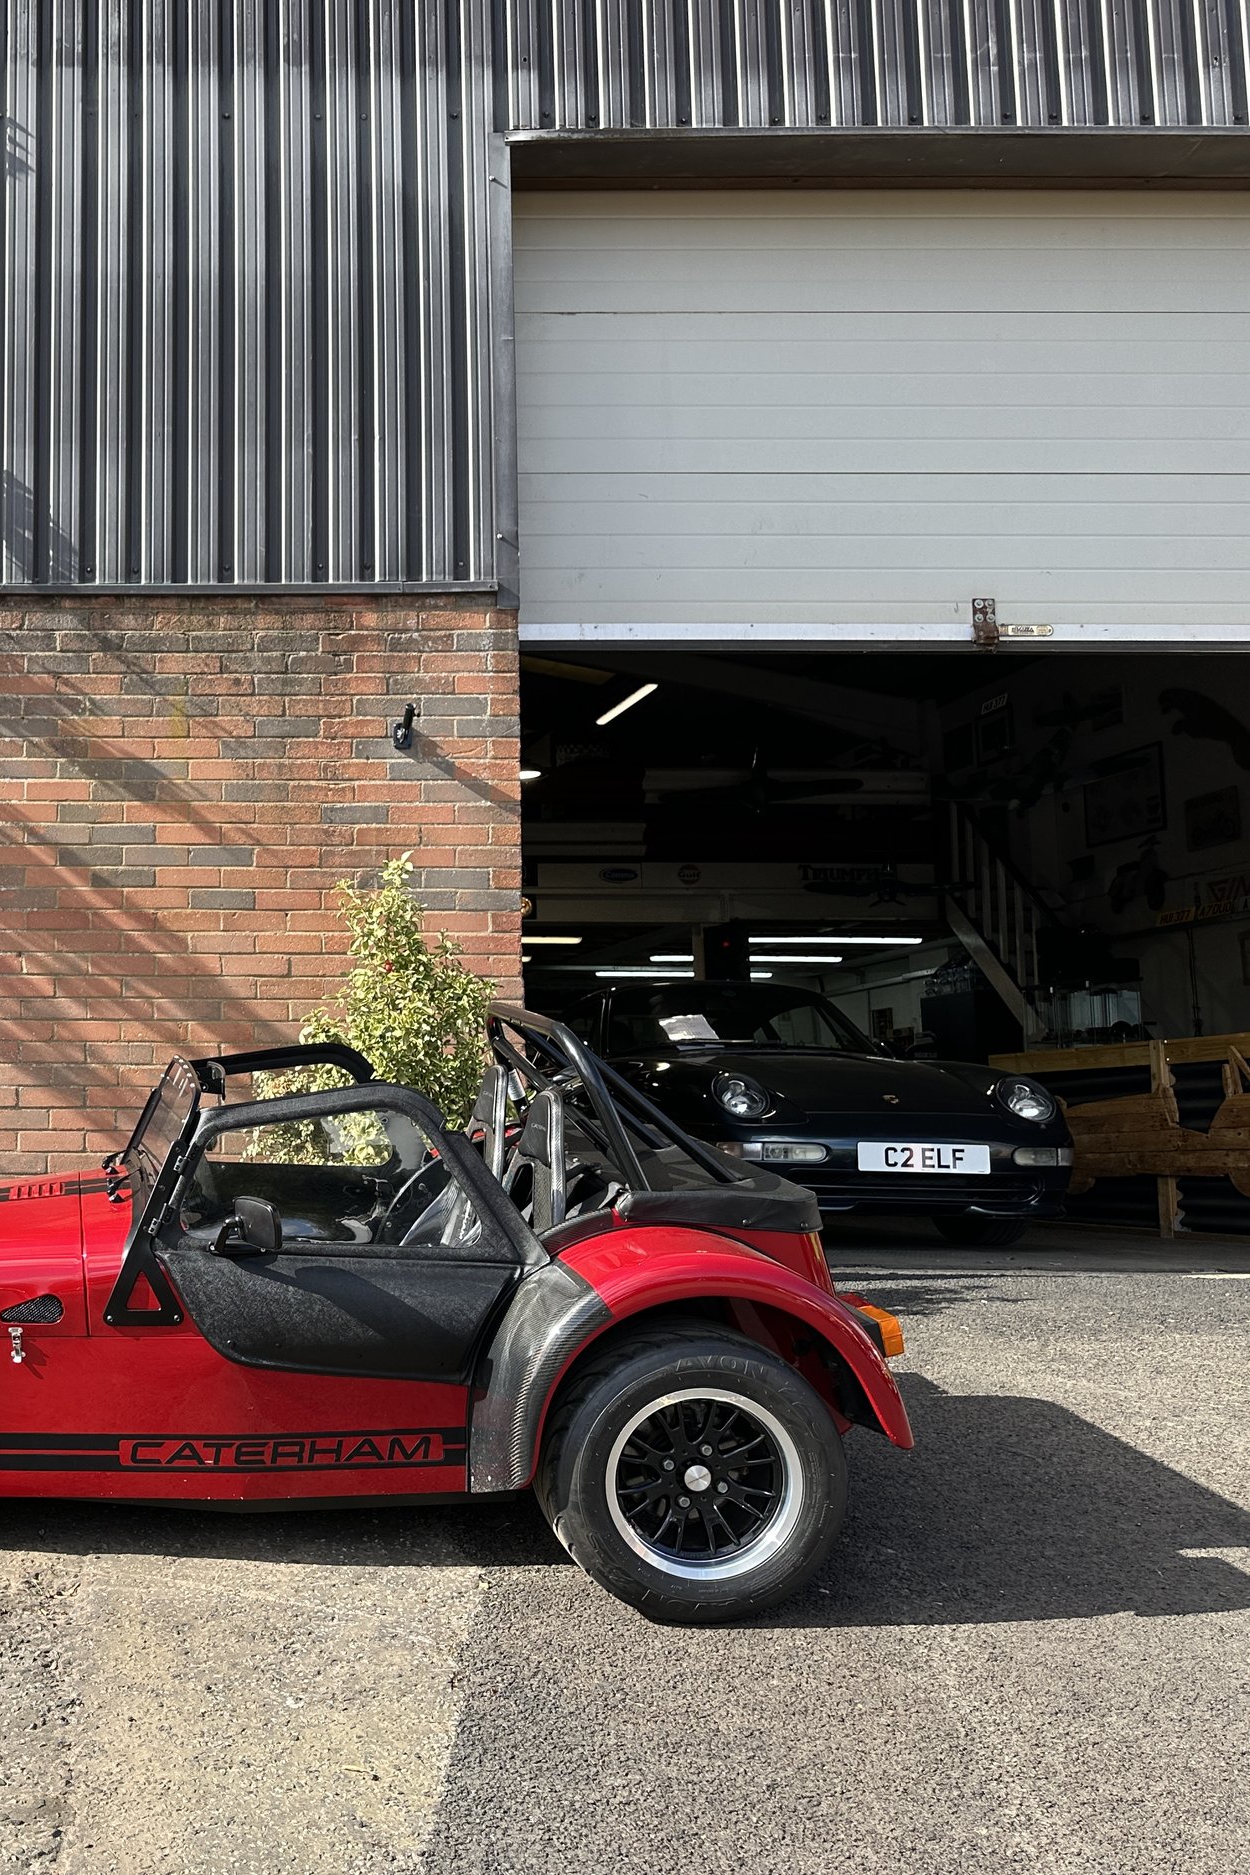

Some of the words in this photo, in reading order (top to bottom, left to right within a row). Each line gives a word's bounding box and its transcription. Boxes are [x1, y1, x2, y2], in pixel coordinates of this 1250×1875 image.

[884, 1146, 914, 1168] C2
[921, 1147, 965, 1169] ELF
[129, 1435, 431, 1465] CATERHAM
